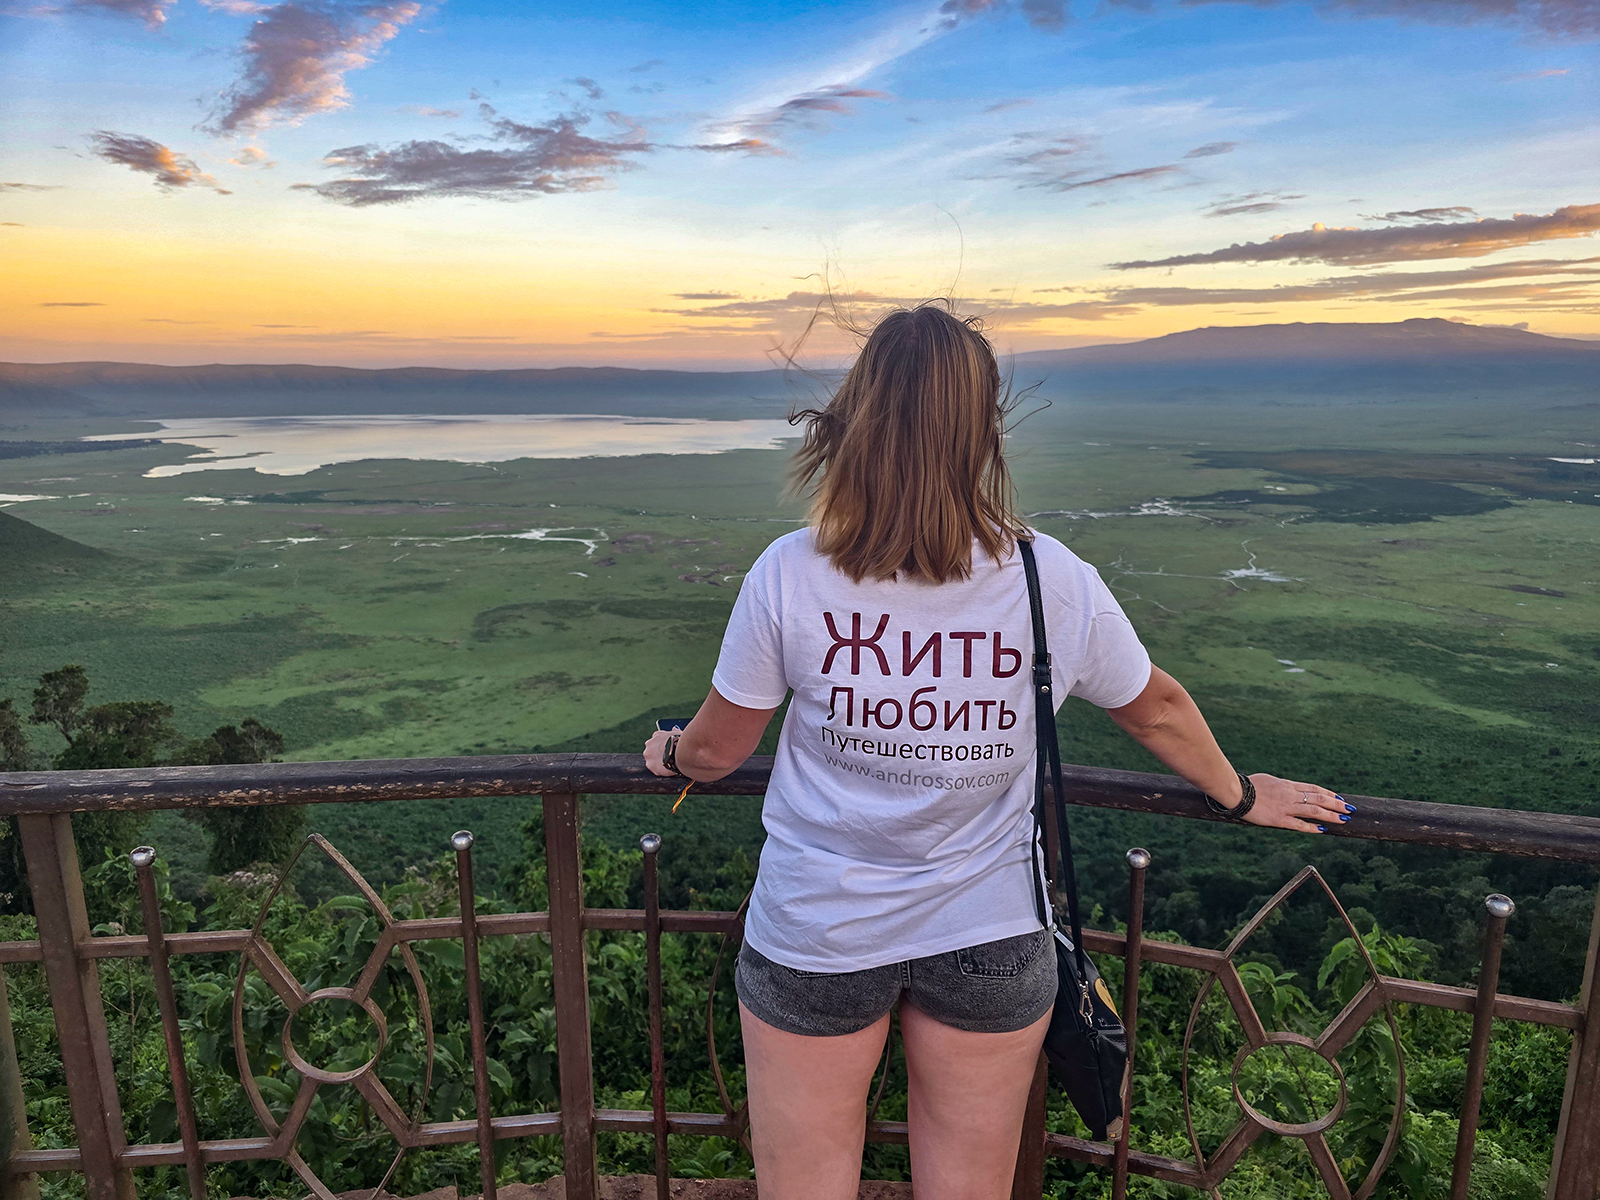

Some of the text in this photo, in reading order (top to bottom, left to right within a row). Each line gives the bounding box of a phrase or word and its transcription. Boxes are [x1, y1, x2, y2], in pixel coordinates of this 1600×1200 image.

[821, 612, 1022, 678] Жить
[827, 686, 1017, 731] Любить
[821, 726, 1014, 761] Путешествовать
[824, 753, 1009, 790] www.androssov.com
